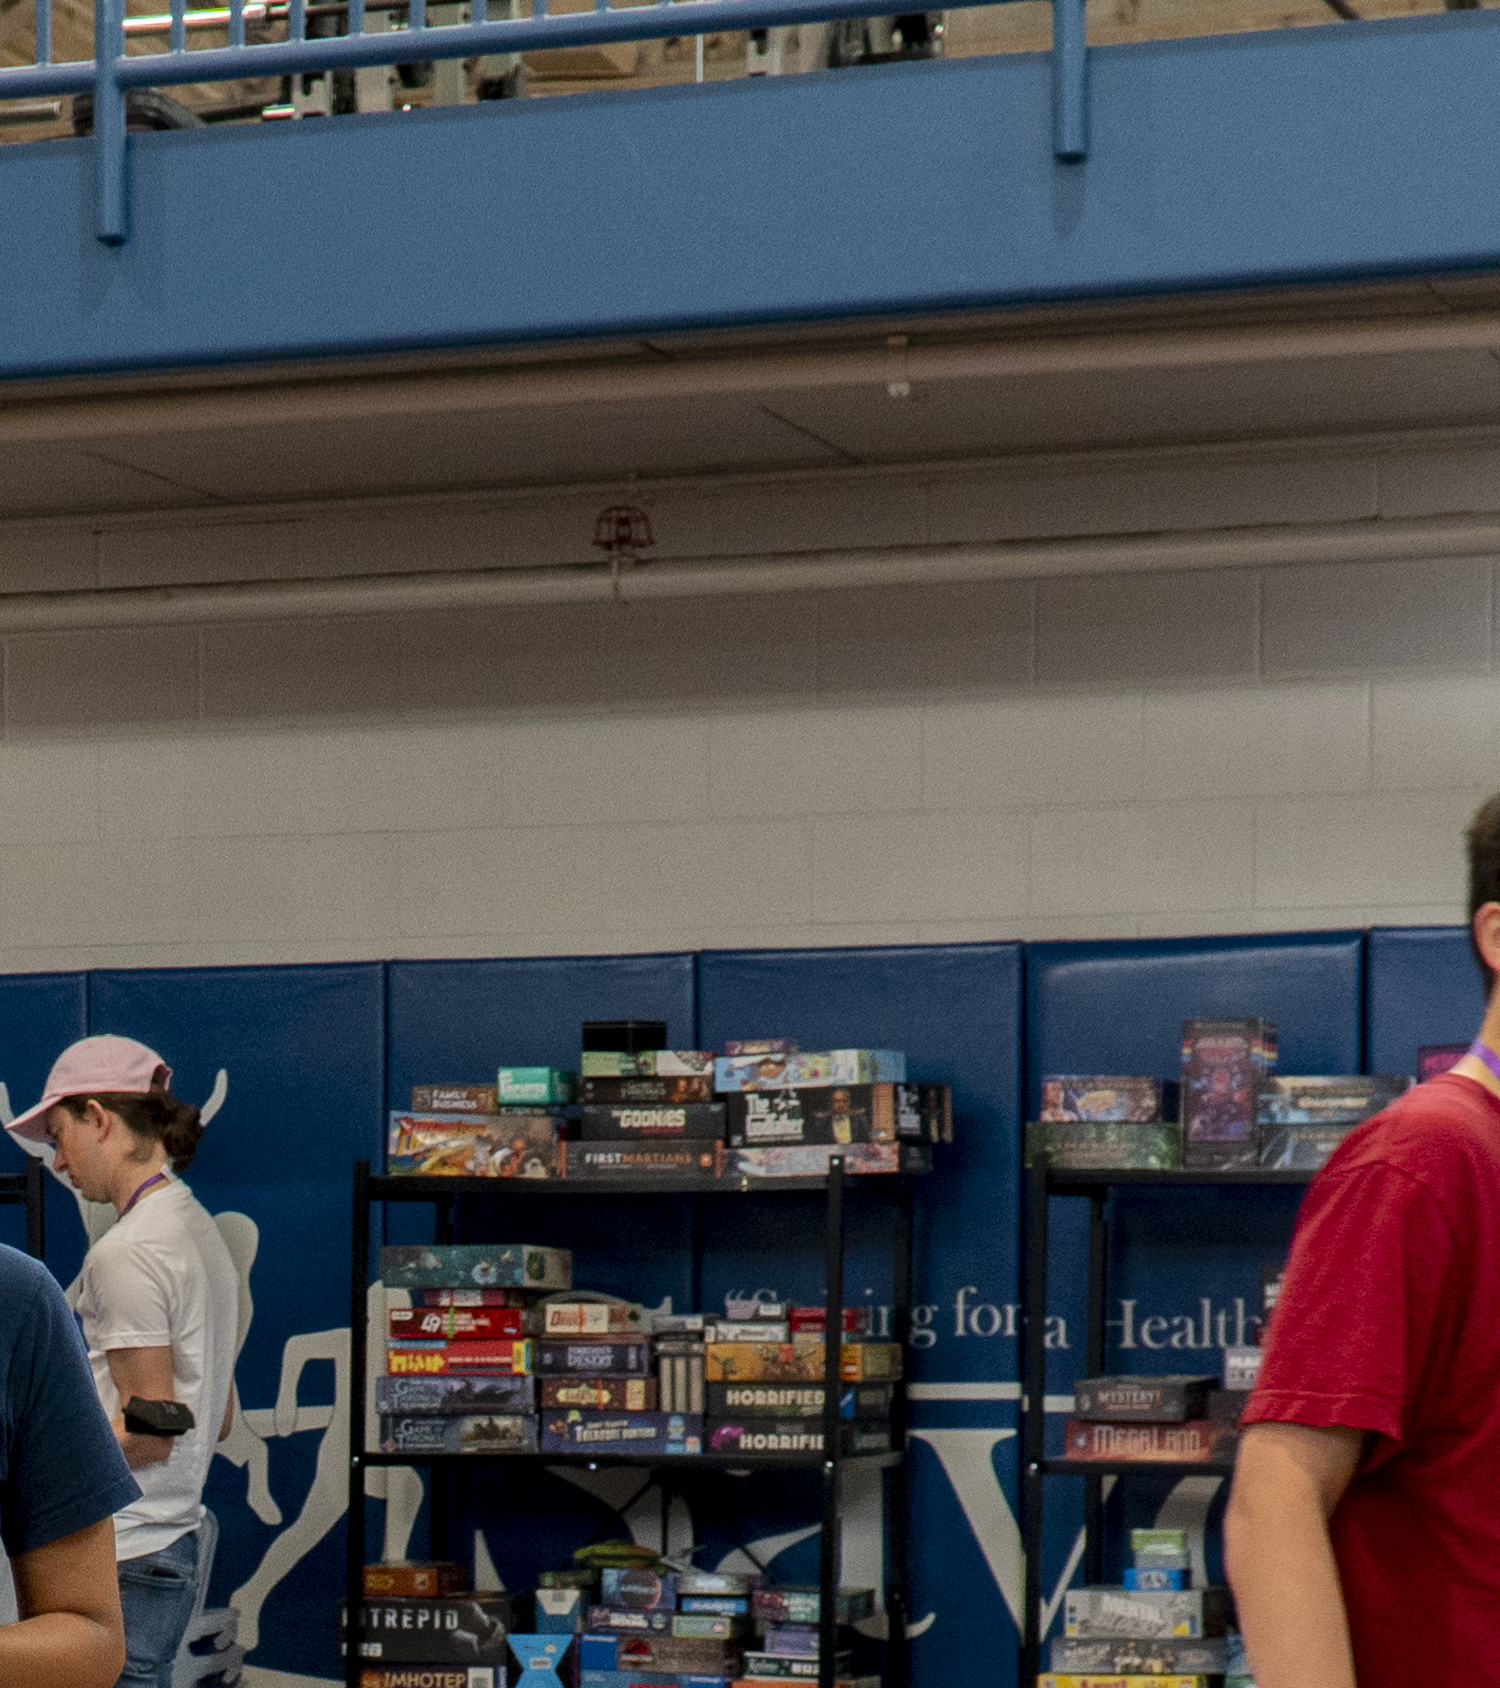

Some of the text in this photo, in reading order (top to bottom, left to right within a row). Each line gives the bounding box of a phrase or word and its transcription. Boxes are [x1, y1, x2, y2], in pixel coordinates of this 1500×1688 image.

[621, 1108, 686, 1128] GOONIES
[585, 1152, 692, 1164] FIRST MARTIANS
[955, 1287, 1022, 1338] for
[1045, 1315, 1071, 1350] a
[726, 1390, 825, 1406] HORRIFIED
[384, 1672, 466, 1688] IMHOTEP
